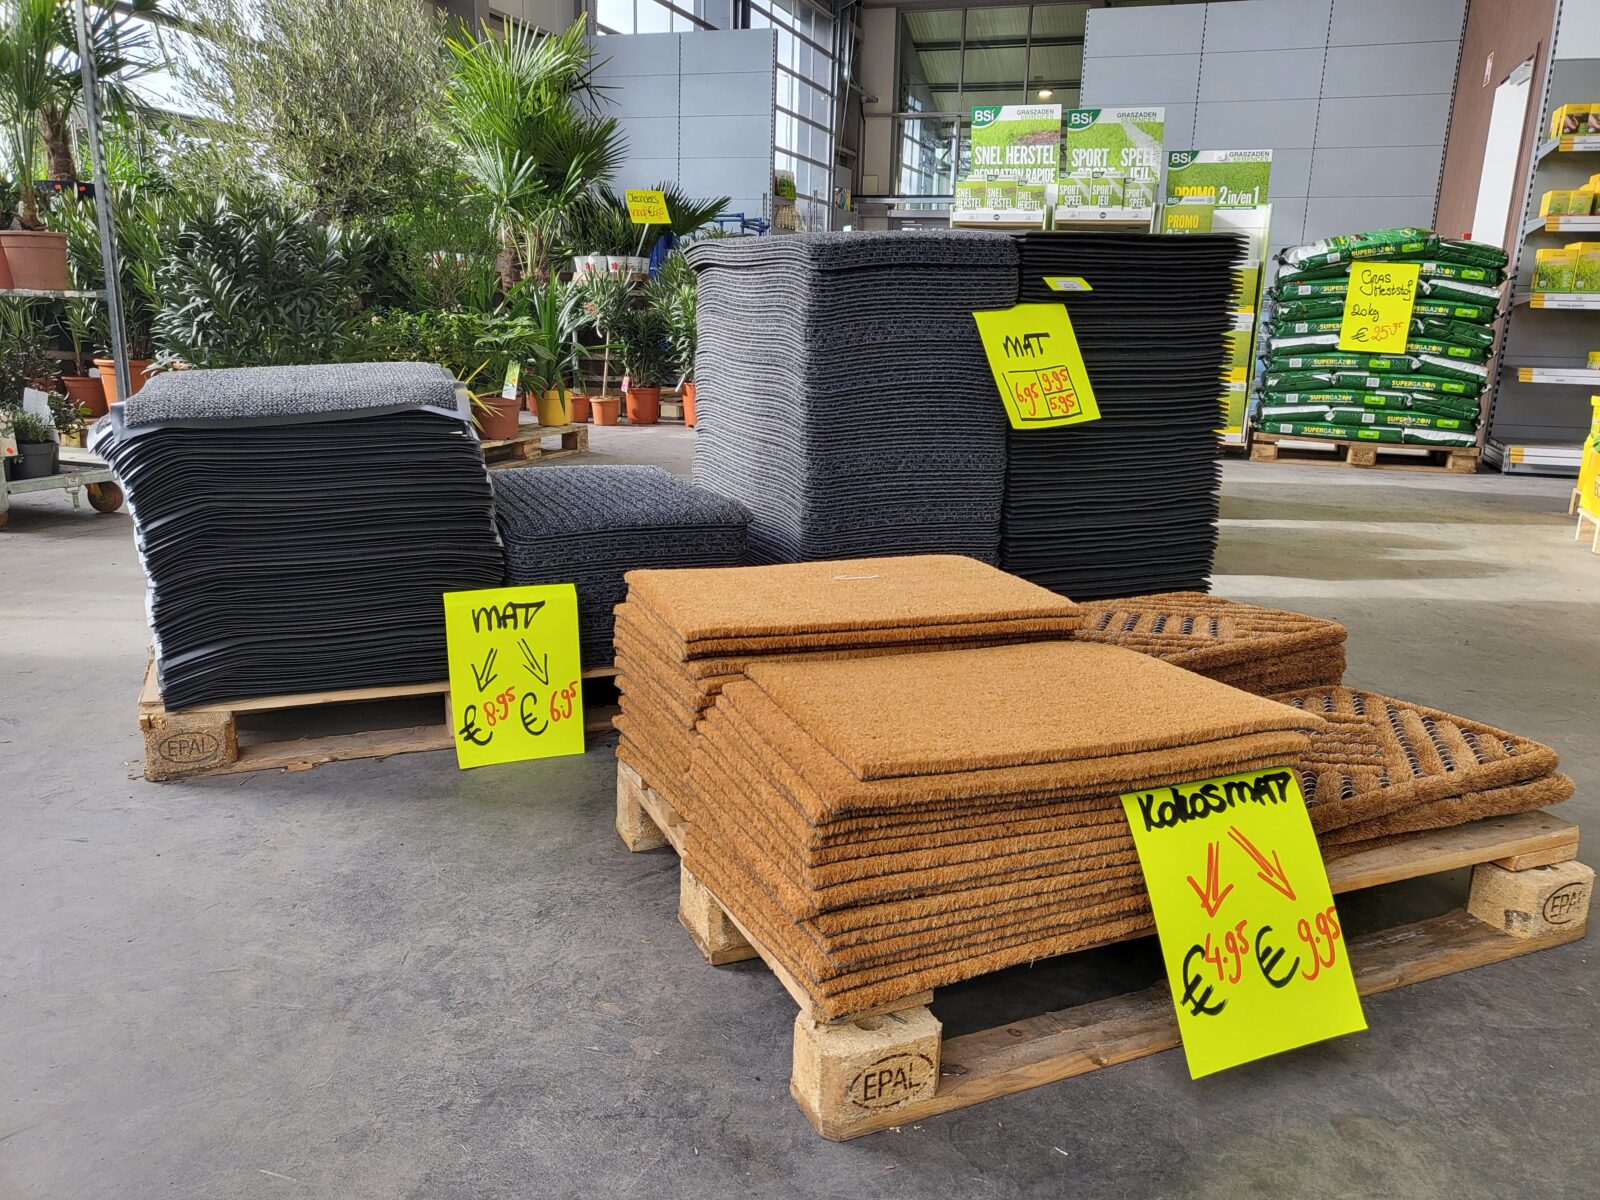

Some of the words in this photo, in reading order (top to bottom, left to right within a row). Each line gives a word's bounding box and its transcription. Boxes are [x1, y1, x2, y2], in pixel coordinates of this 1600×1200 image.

[975, 145, 1002, 165] SNEL
[1006, 144, 1056, 165] HERSTEL
[1071, 148, 1109, 167] SPORT
[1120, 147, 1157, 167] SPEEL
[1025, 168, 1056, 182] RAPIDE
[957, 188, 972, 197] SNEL
[987, 188, 1003, 197] SNEL
[1059, 185, 1079, 195] SPORT
[1092, 185, 1112, 195] SPORT
[1125, 189, 1143, 197] SPORT
[1018, 192, 1032, 200] SNEL
[1218, 186, 1228, 205] 2
[1253, 186, 1260, 205] 1
[957, 198, 982, 207] HERSTEL
[987, 198, 1013, 207] HERSTEL
[1018, 201, 1040, 209] HERSTEL
[1064, 196, 1082, 205] SPEEL
[1098, 196, 1109, 205] JEU
[1129, 199, 1145, 207] SPEEL
[1167, 215, 1199, 228] PROMO
[1351, 246, 1396, 256] SUPERGAZON
[1003, 332, 1050, 358] MAT
[1392, 380, 1436, 388] SUPERGAZON
[1387, 416, 1431, 424] SUPERGAZON
[1304, 427, 1346, 435] SUPERGAZON
[472, 600, 545, 633] MAT
[167, 736, 213, 757] EPAL
[864, 1062, 920, 1101] EPAL
